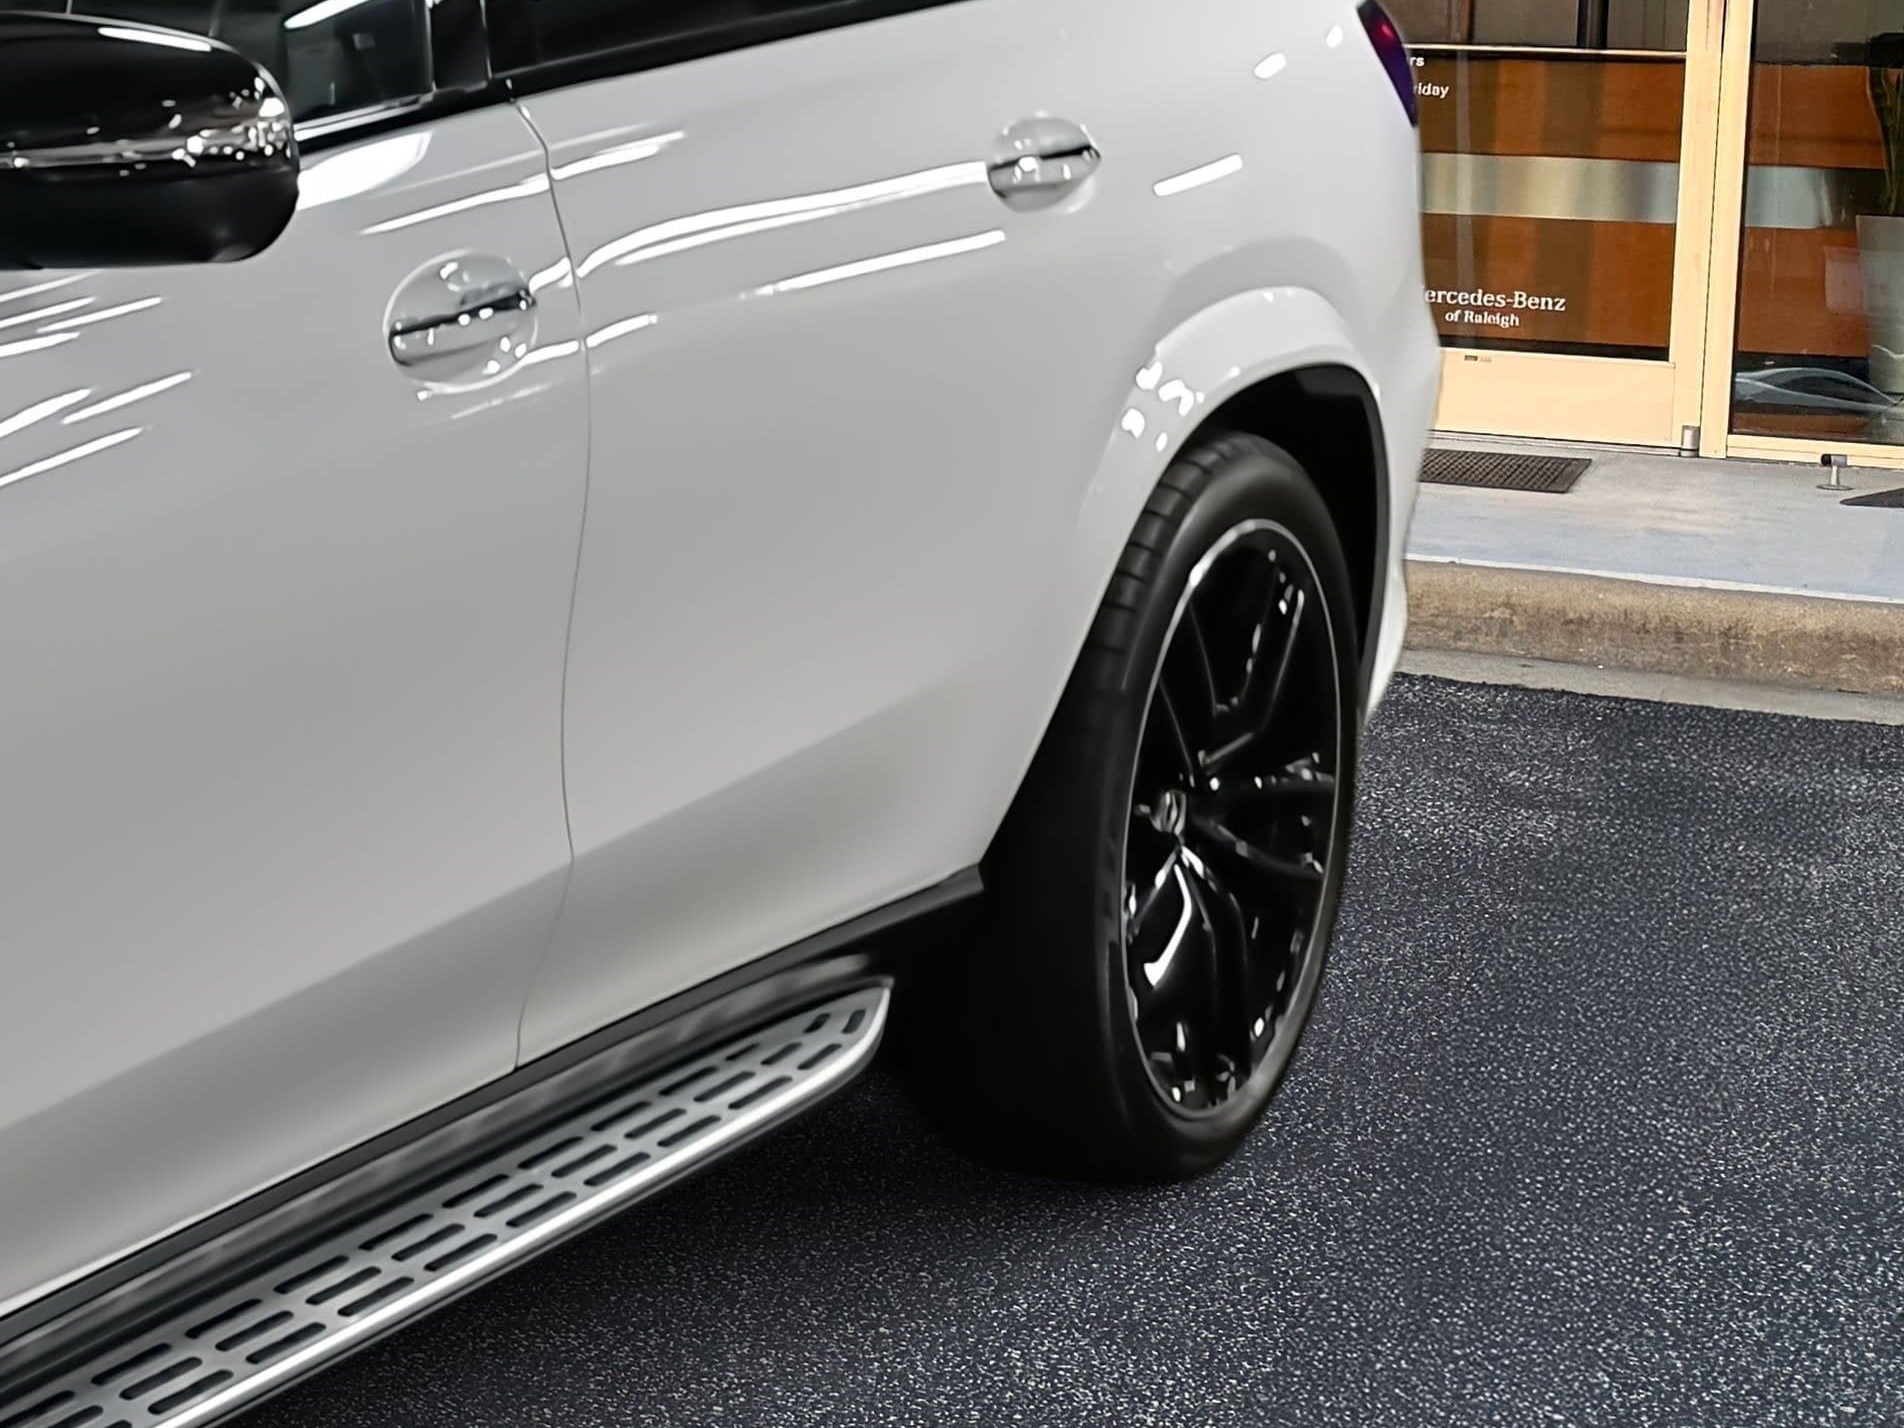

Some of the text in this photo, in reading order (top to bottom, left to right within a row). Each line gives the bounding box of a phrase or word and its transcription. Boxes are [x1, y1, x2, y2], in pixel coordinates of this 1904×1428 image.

[1413, 82, 1449, 98] riday
[1423, 287, 1567, 312] ercedes-Benz
[1445, 309, 1520, 329] of Raleigh
